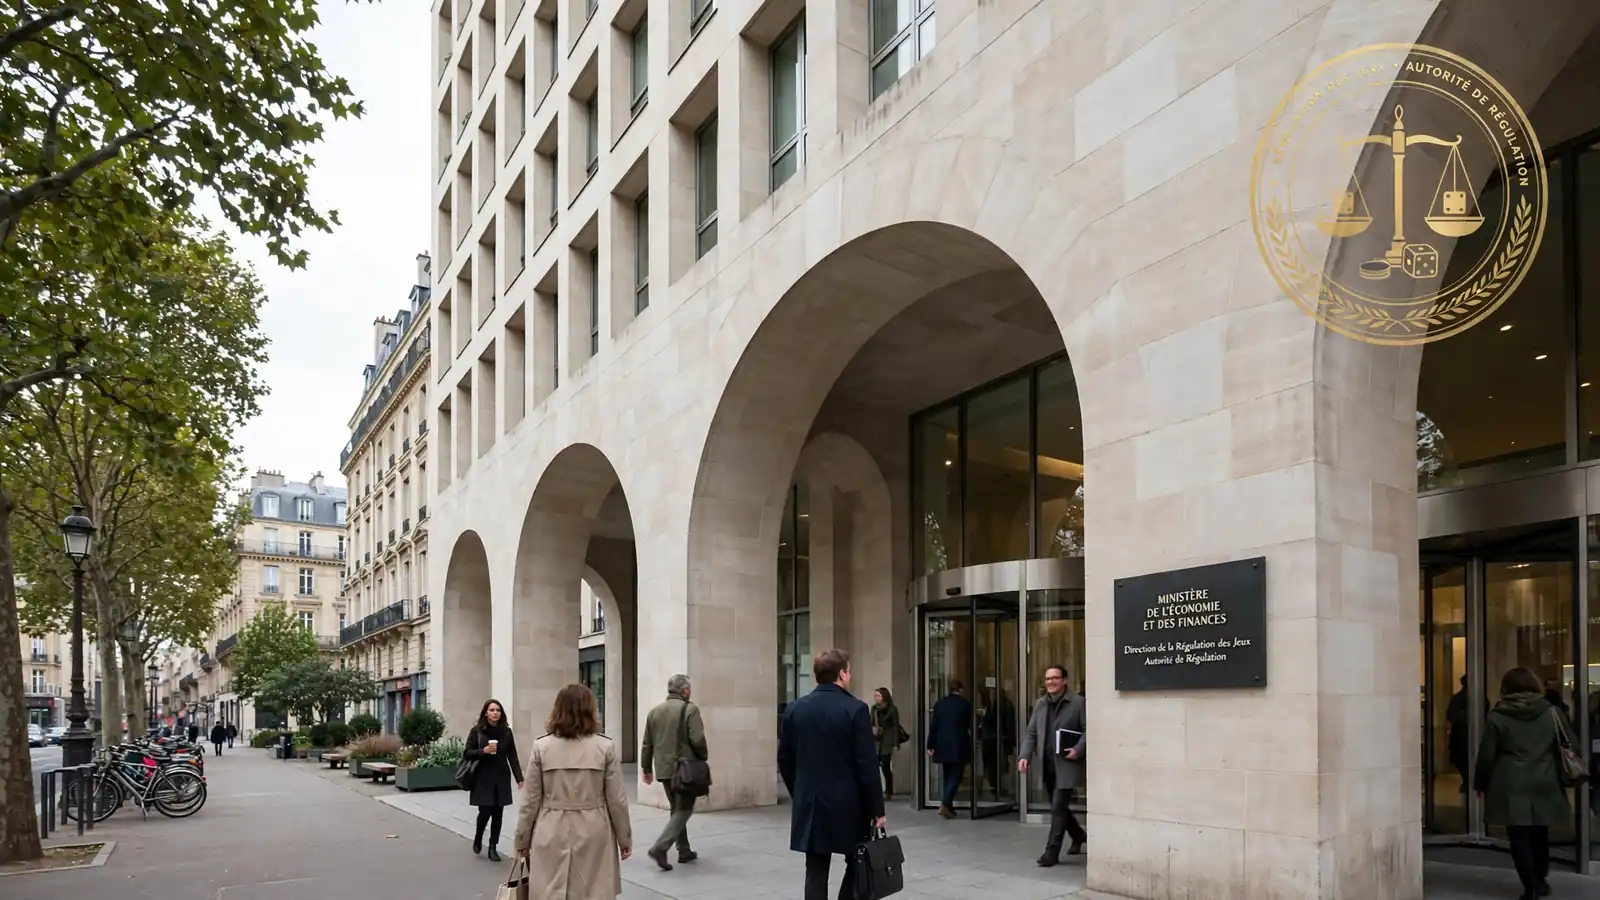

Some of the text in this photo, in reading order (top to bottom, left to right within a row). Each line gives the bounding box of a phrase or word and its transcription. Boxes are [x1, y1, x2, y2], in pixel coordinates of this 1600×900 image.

[1158, 588, 1209, 604] MINISTÈRE
[1147, 601, 1220, 618] DE L'ÉCONOMIE
[1144, 614, 1227, 630] ET DES FINANCES
[1124, 637, 1251, 654] Direction de la Régulation des Jeux
[1144, 652, 1226, 666] Autorité de Régulation
